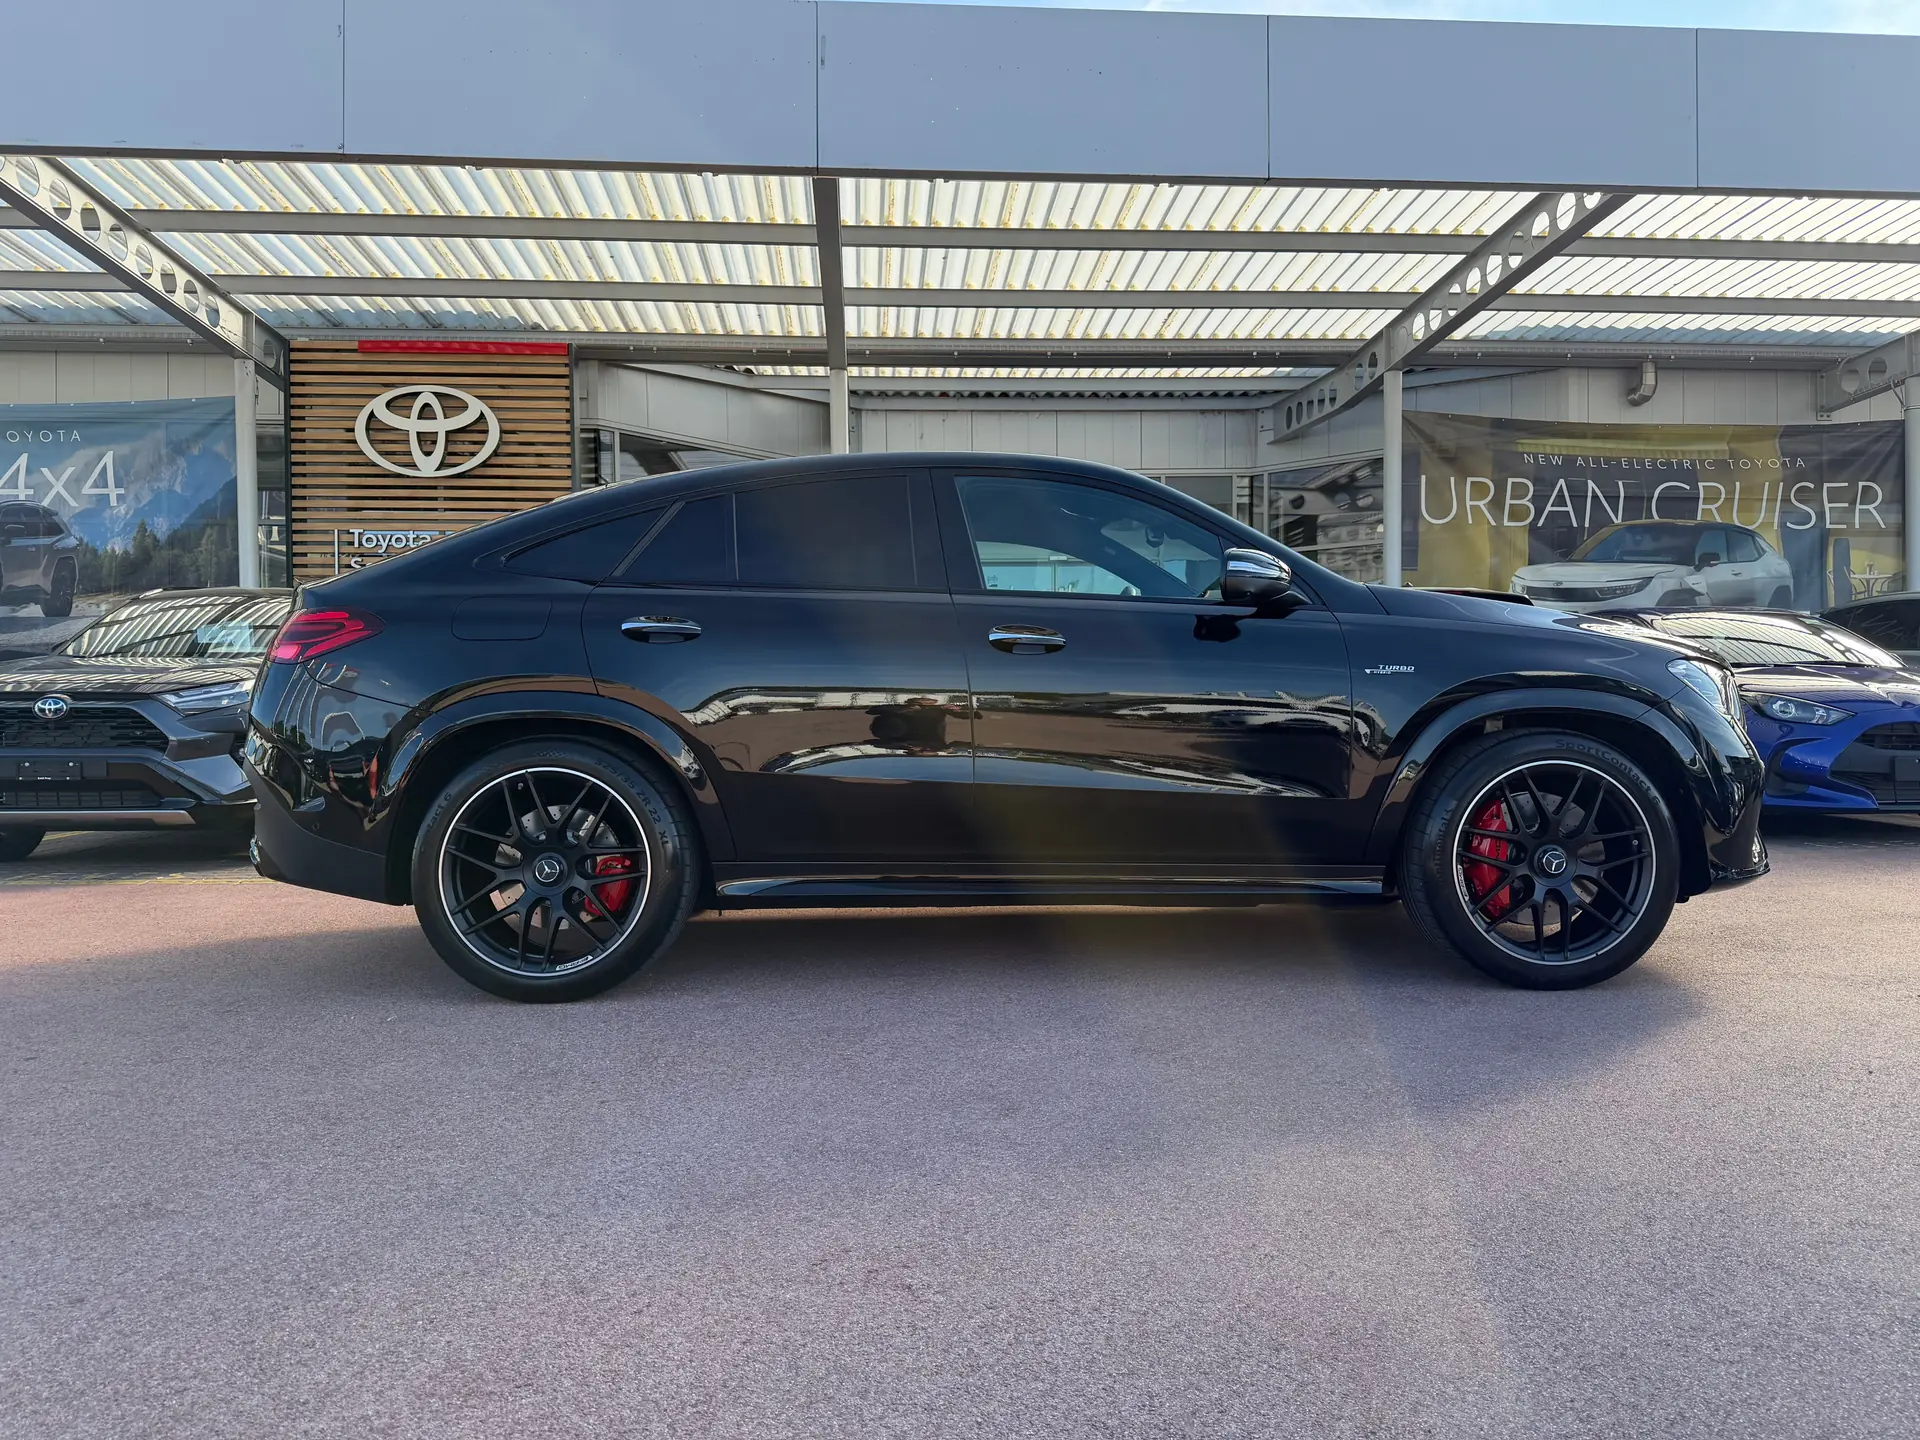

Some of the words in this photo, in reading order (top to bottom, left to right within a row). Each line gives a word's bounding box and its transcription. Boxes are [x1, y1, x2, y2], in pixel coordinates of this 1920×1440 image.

[6, 430, 81, 443] OYOTA
[1523, 453, 1563, 466] NEW
[1576, 456, 1716, 470] ALL-ELECTRIC
[1727, 457, 1806, 470] TOYOTA
[0, 450, 125, 507] 4x4
[1420, 474, 1625, 528] URBAN
[1651, 481, 1887, 530] CRUISER
[349, 529, 432, 553] Toyota
[1555, 738, 1651, 789] SportContact
[647, 807, 662, 825] 22
